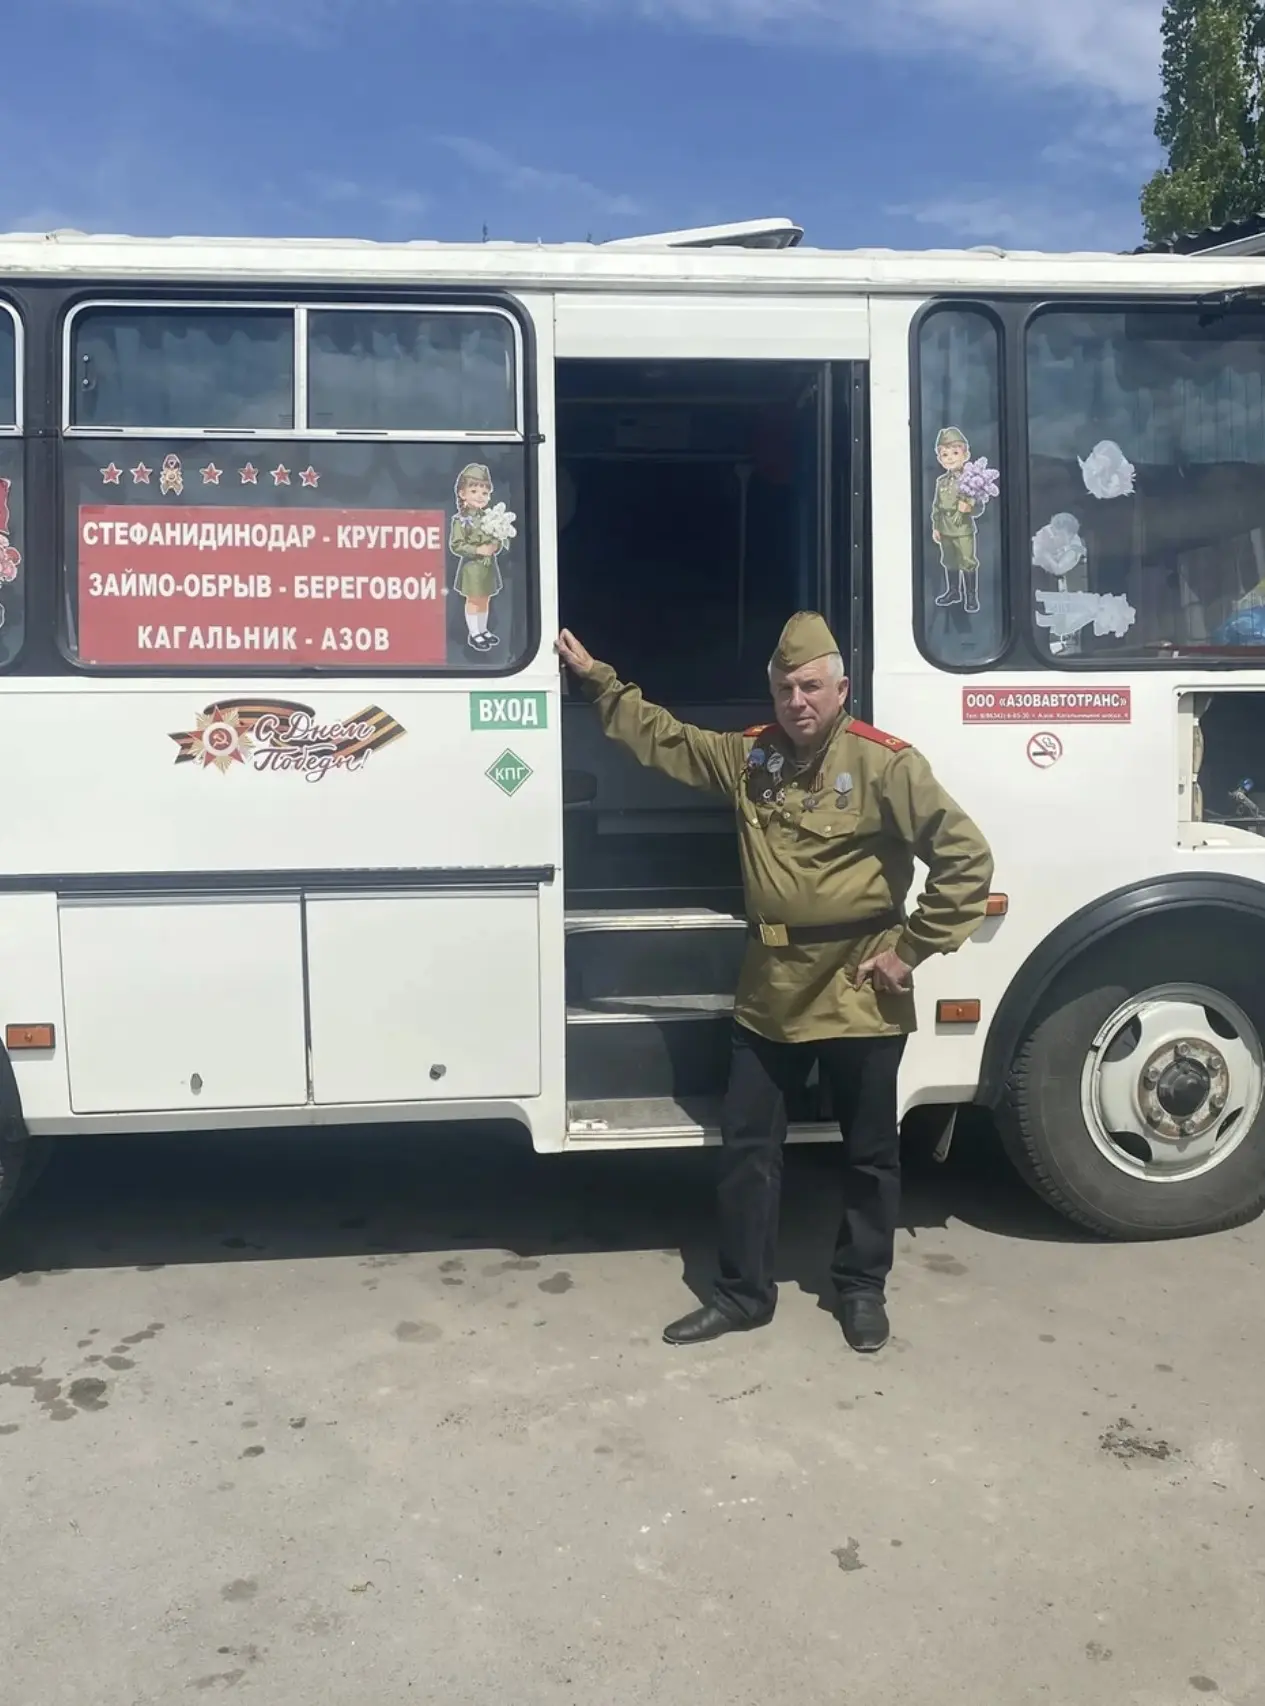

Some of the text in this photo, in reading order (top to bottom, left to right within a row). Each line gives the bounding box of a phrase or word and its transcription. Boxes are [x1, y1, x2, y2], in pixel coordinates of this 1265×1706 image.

[82, 521, 316, 552] СТЕФАНИДИНОДАР
[337, 524, 441, 550] КРУГЛОЕ
[88, 568, 272, 598] ЗАЙМО-ОБРЫВ
[294, 572, 437, 600] БЕРЕГОВОЙ
[137, 625, 298, 650] КАГАЛЬНИК
[320, 627, 390, 651] АЗОВ
[479, 697, 539, 726] ВХОД
[966, 693, 1127, 708] ООО «АЗОВАВТОТРАНС»
[254, 714, 279, 742] С
[253, 743, 368, 783] Победы!
[495, 767, 525, 781] КПГ
